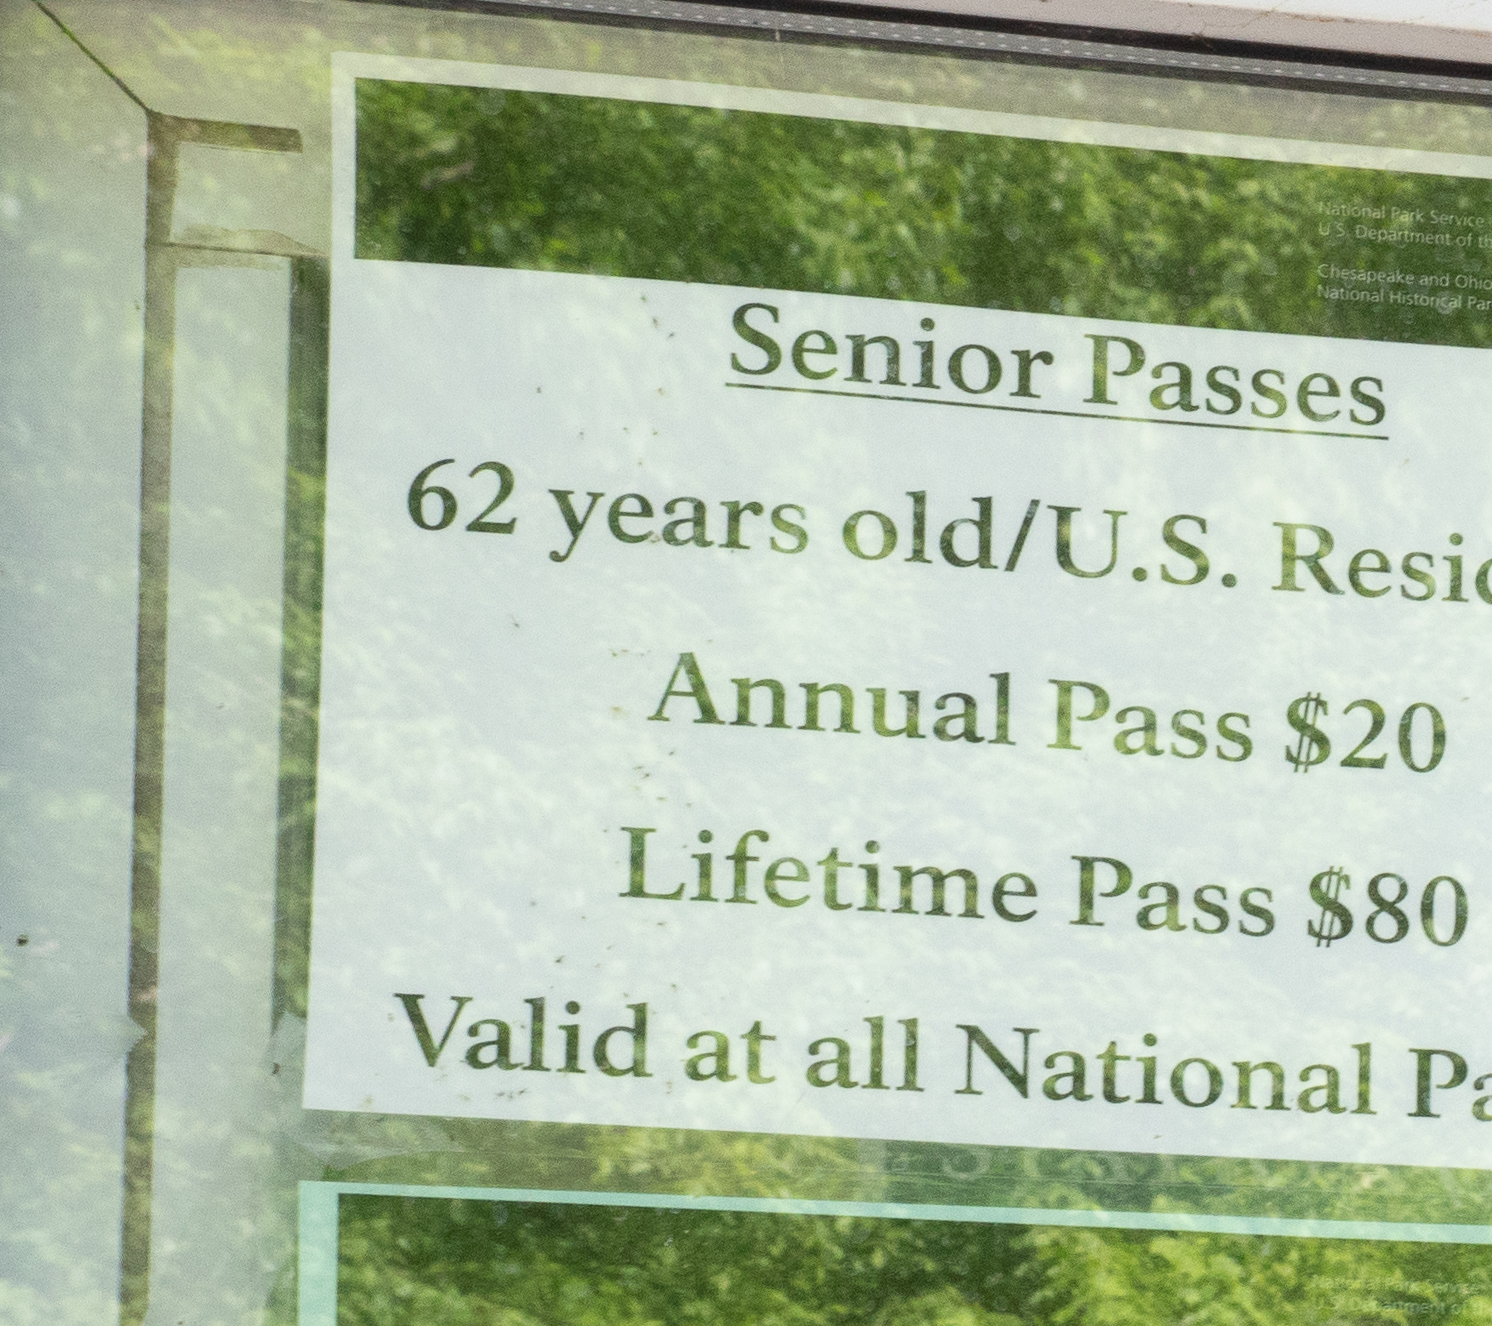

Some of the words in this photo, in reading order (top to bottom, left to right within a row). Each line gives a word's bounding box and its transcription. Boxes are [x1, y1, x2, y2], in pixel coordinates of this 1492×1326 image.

[1317, 263, 1415, 288] Chesapeake
[1419, 269, 1450, 288] and
[1455, 273, 1492, 290] Ohio
[1356, 224, 1453, 248] Department
[1428, 208, 1484, 228] Service
[730, 301, 1053, 404] Senior
[1082, 332, 1389, 428] Passes
[407, 459, 518, 537] 62
[548, 484, 809, 562] years
[841, 490, 1240, 590] old/U.S.
[648, 651, 1016, 749] Annual
[1047, 678, 1255, 765] Pass
[1284, 691, 1449, 775] $20
[619, 826, 1038, 924] Lifetime
[1070, 856, 1275, 939] Pass
[1307, 866, 1470, 950] $80
[395, 992, 651, 1080] Valid
[684, 1017, 776, 1086] at
[805, 1015, 923, 1094] all
[956, 1023, 1377, 1118] National
